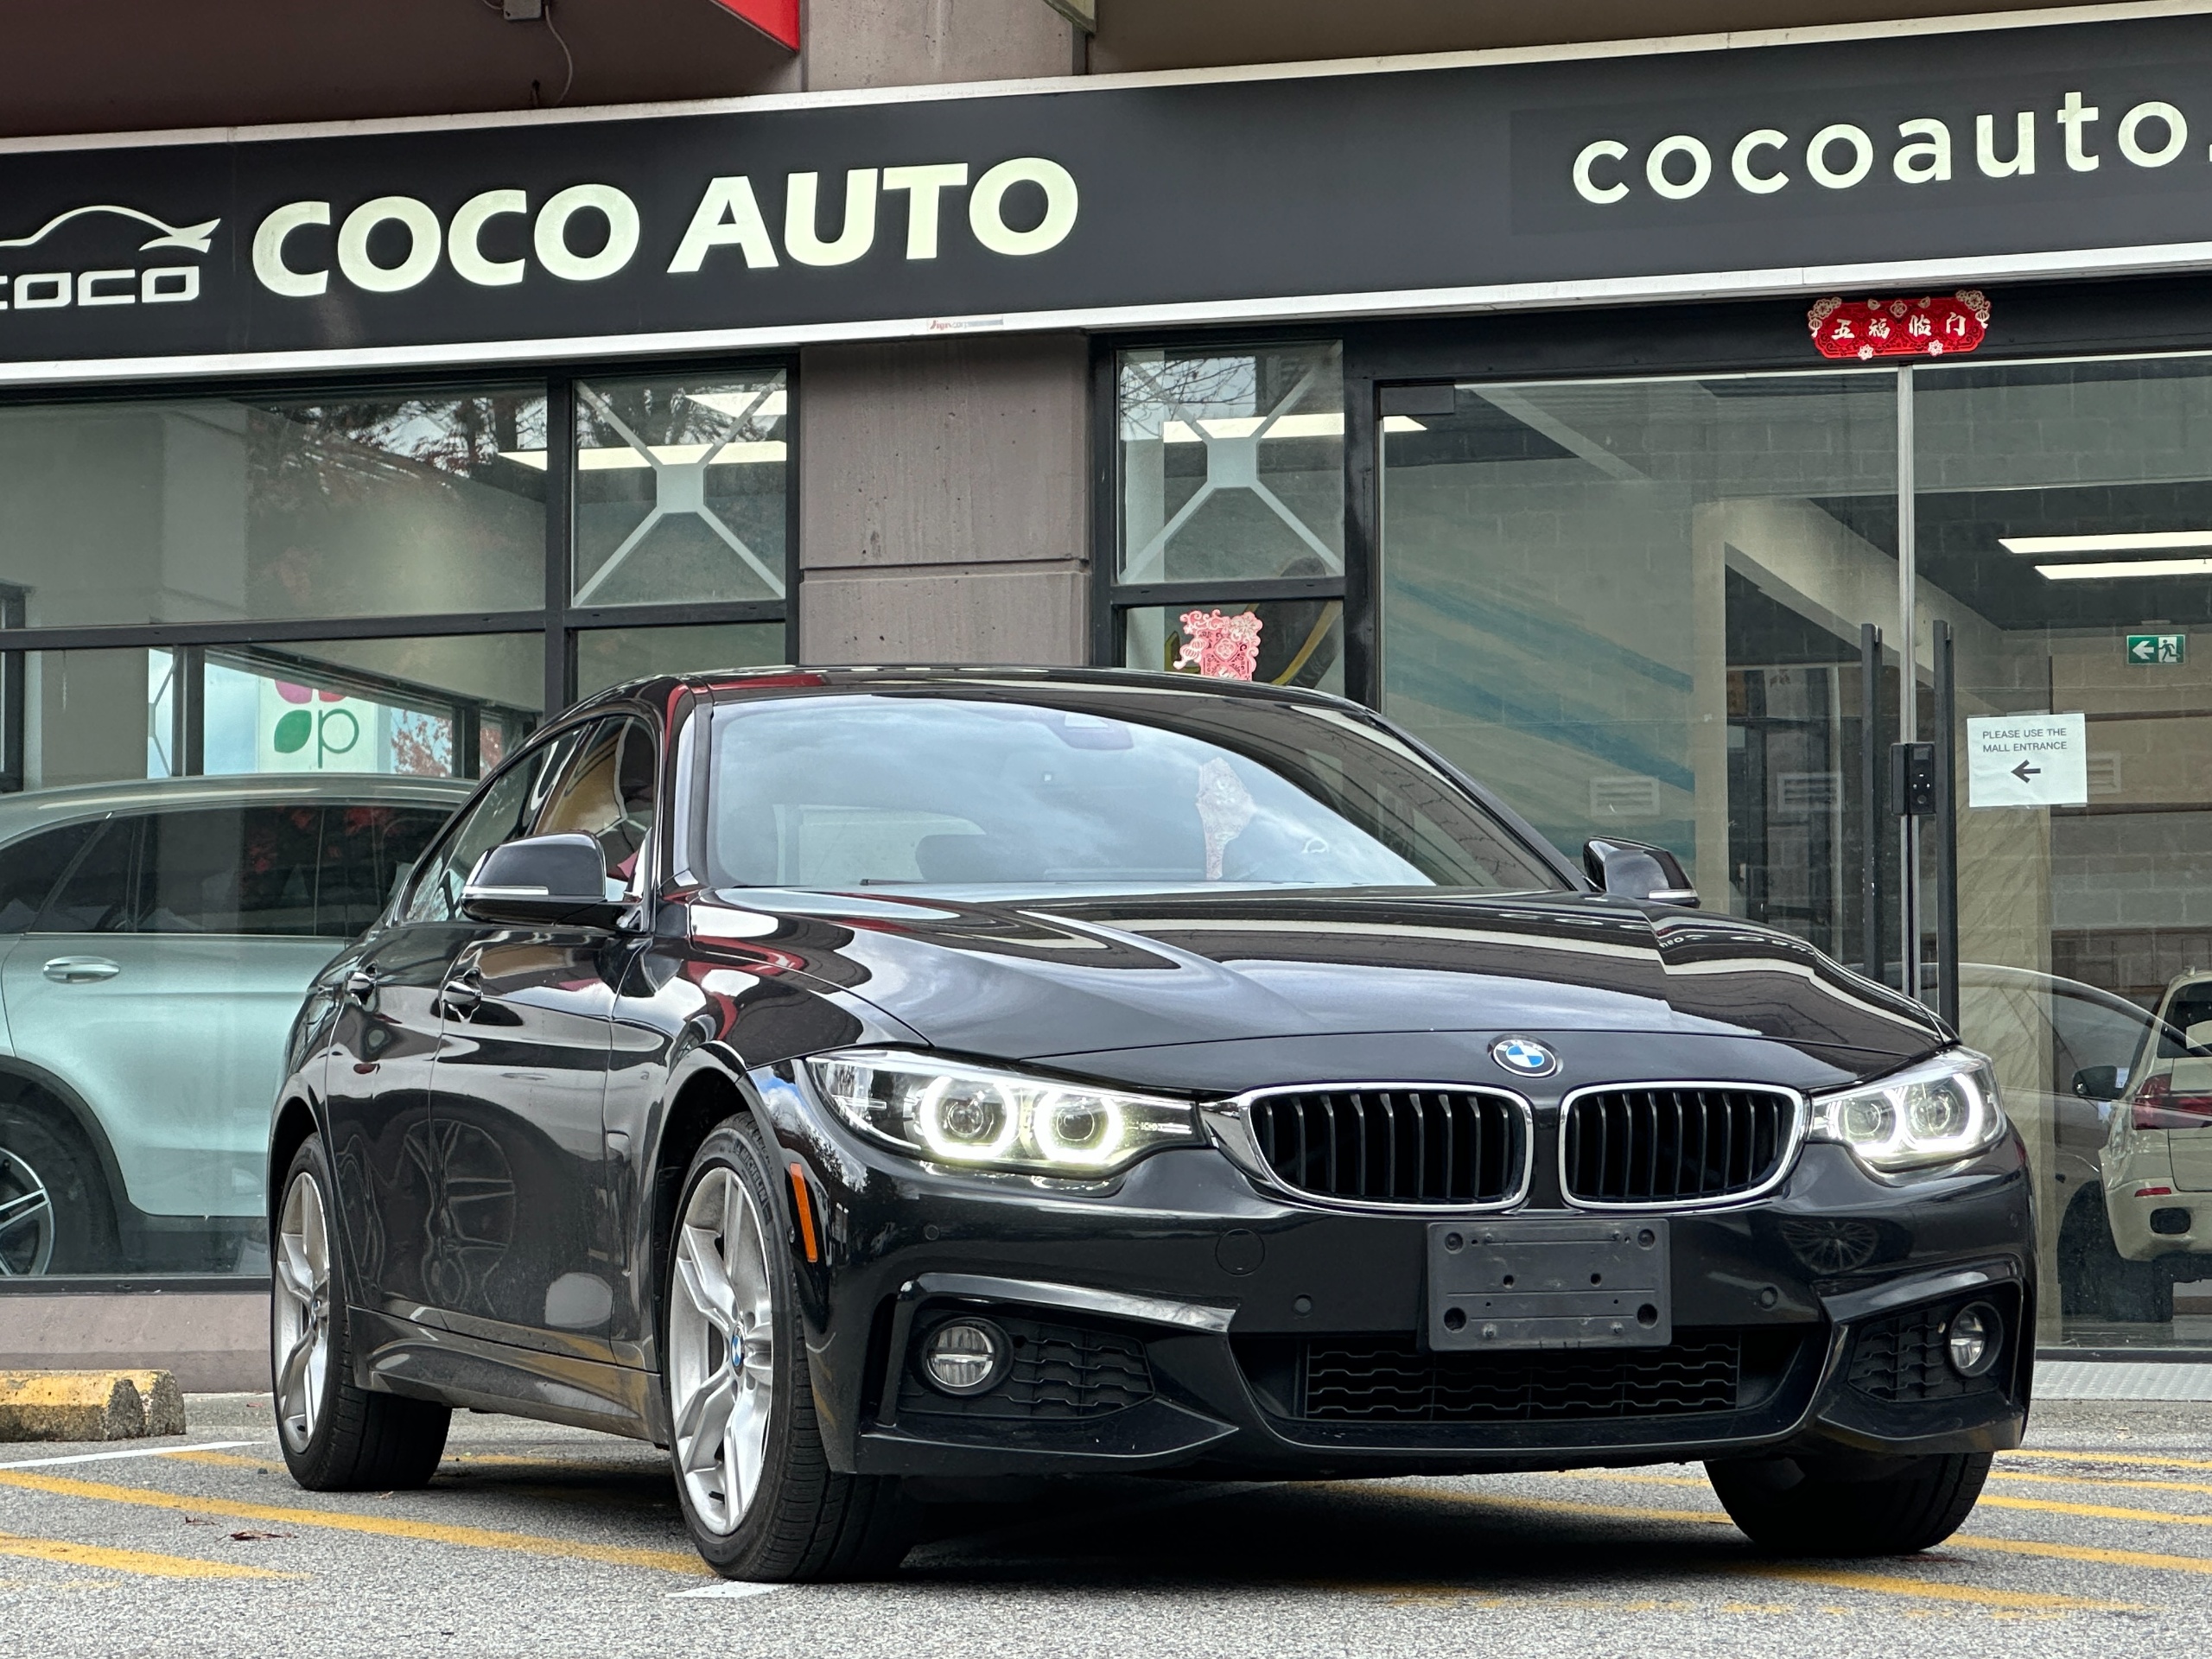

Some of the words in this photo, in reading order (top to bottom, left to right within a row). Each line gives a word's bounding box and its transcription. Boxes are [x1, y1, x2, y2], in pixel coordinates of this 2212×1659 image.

[1573, 92, 2212, 204] cocoauto
[253, 184, 639, 296] COCO
[667, 158, 1077, 273] AUTO
[0, 266, 199, 309] OCO
[1831, 312, 1967, 340] 五福临门
[1982, 729, 2020, 739] PLEASE
[2024, 728, 2044, 737] USE
[1982, 743, 2011, 753] MALL
[2013, 741, 2068, 752] ENTRANCE
[741, 1148, 768, 1204] MICHELIN
